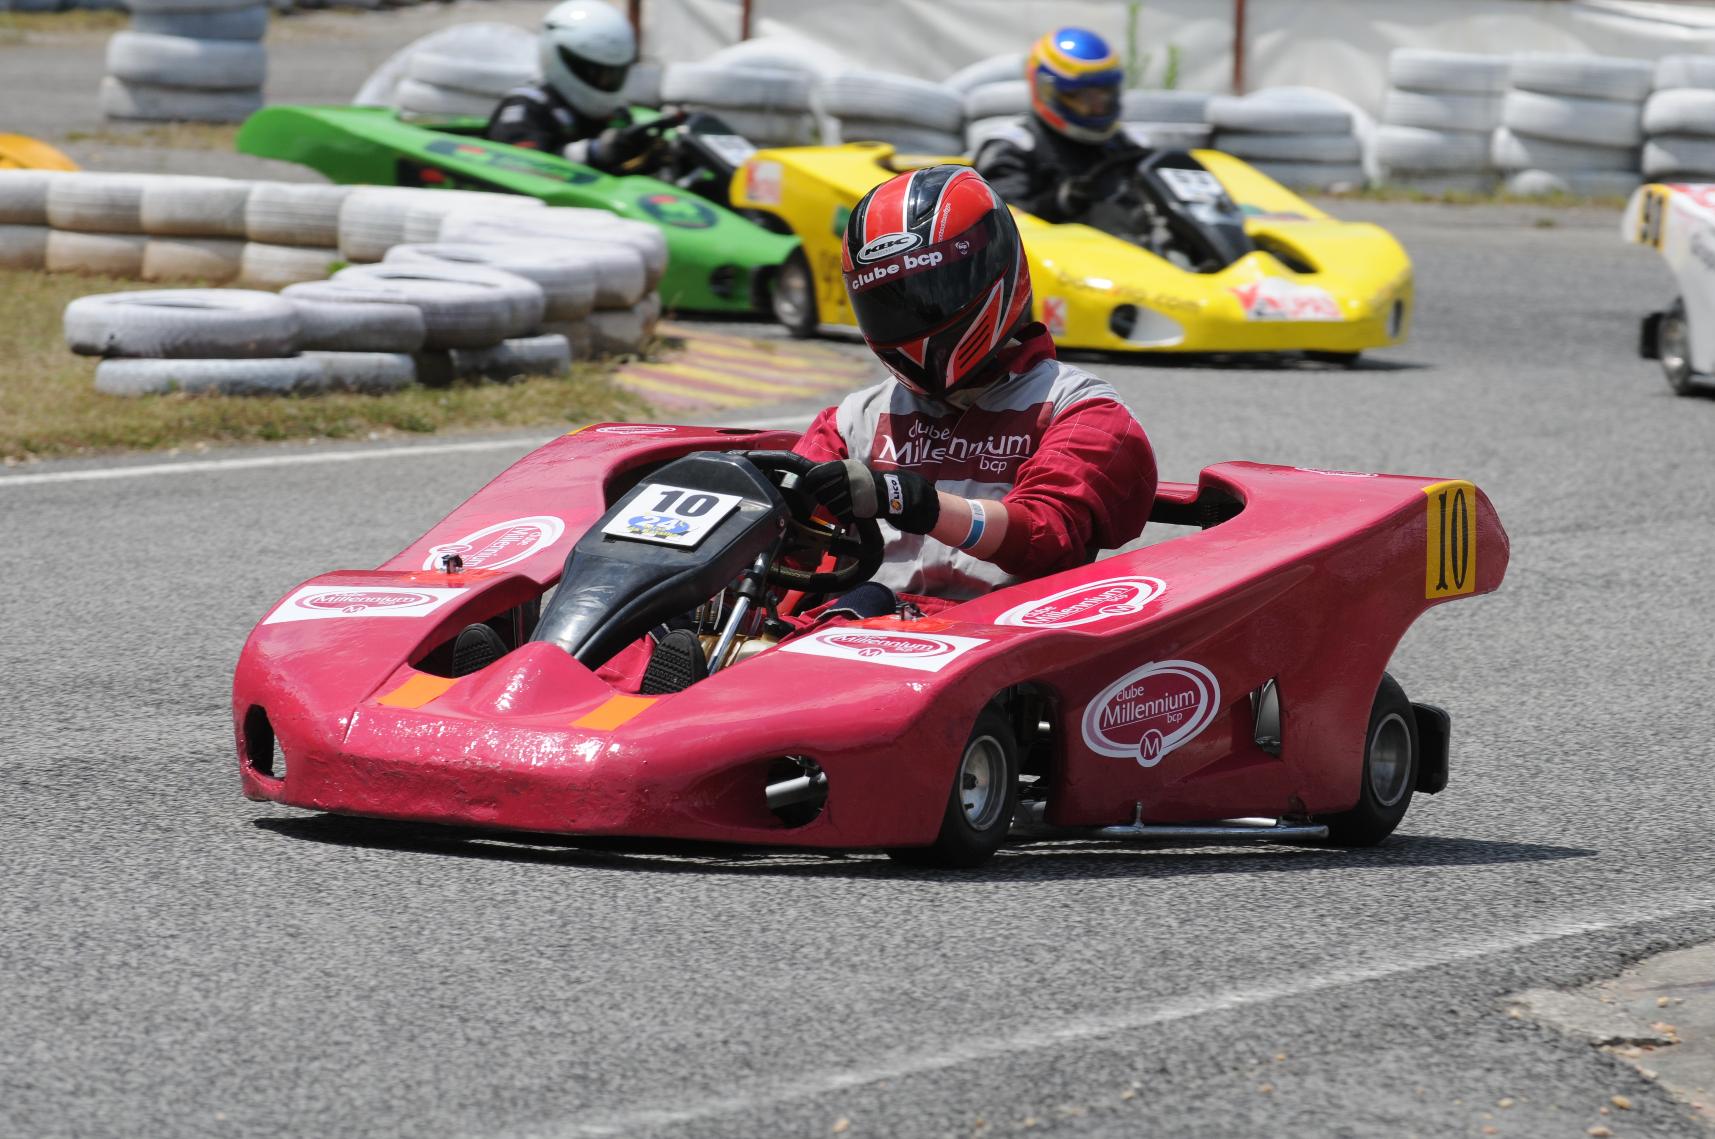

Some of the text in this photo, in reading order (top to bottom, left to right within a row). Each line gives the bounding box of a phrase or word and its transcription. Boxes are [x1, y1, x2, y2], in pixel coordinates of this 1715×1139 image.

[864, 236, 910, 256] KBC
[852, 264, 900, 290] clube
[903, 251, 943, 270] bcp
[979, 456, 1007, 475] bcp
[891, 479, 900, 500] LICO
[651, 490, 720, 517] 10
[1435, 488, 1469, 591] 10
[1116, 685, 1145, 702] clube
[1103, 690, 1195, 727] Millennium
[1167, 712, 1183, 724] bcp
[1142, 736, 1160, 758] M
